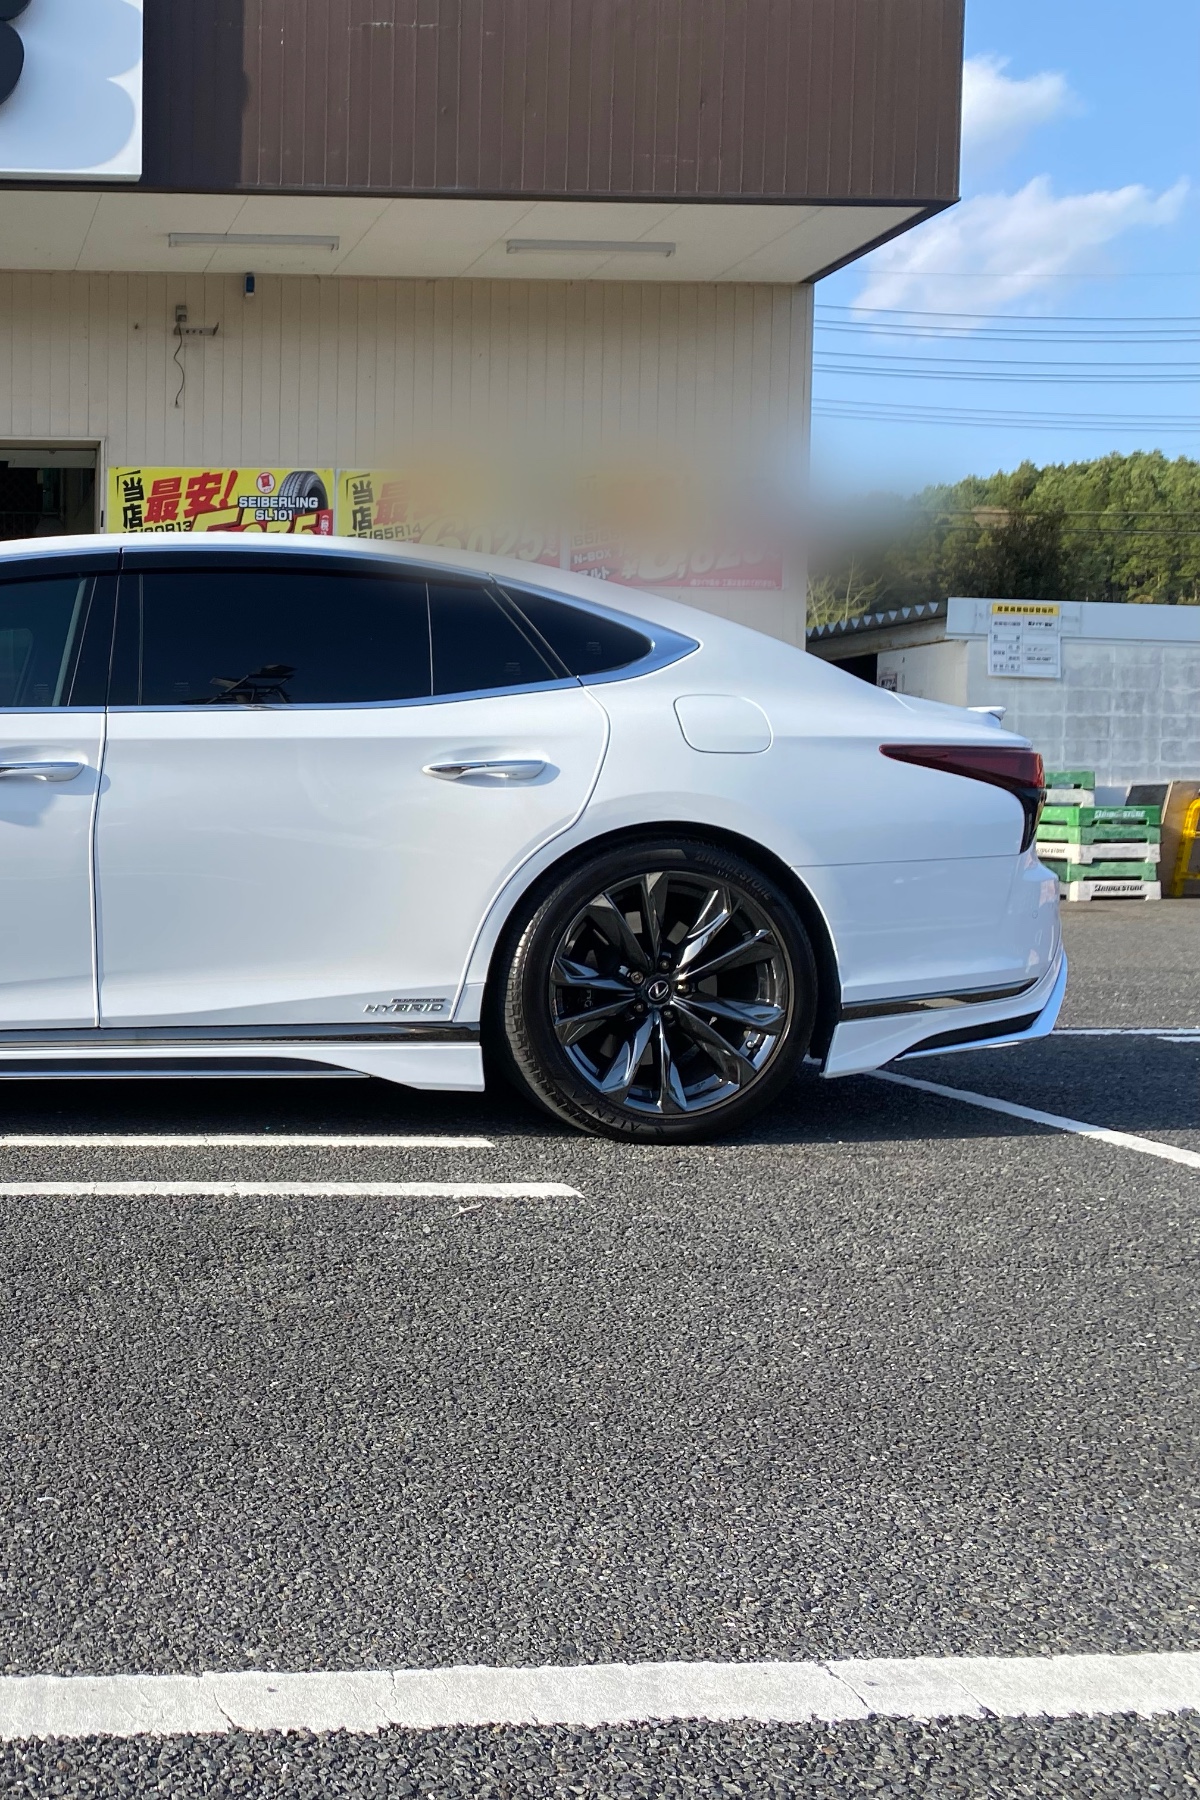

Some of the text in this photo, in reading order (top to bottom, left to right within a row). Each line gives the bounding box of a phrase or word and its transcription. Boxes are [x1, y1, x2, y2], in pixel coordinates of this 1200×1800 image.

[122, 476, 144, 529] 当店
[238, 496, 319, 509] SEIBERLING
[352, 479, 374, 531] 当店
[255, 509, 293, 522] SL101
[363, 1003, 444, 1013] HYBRID
